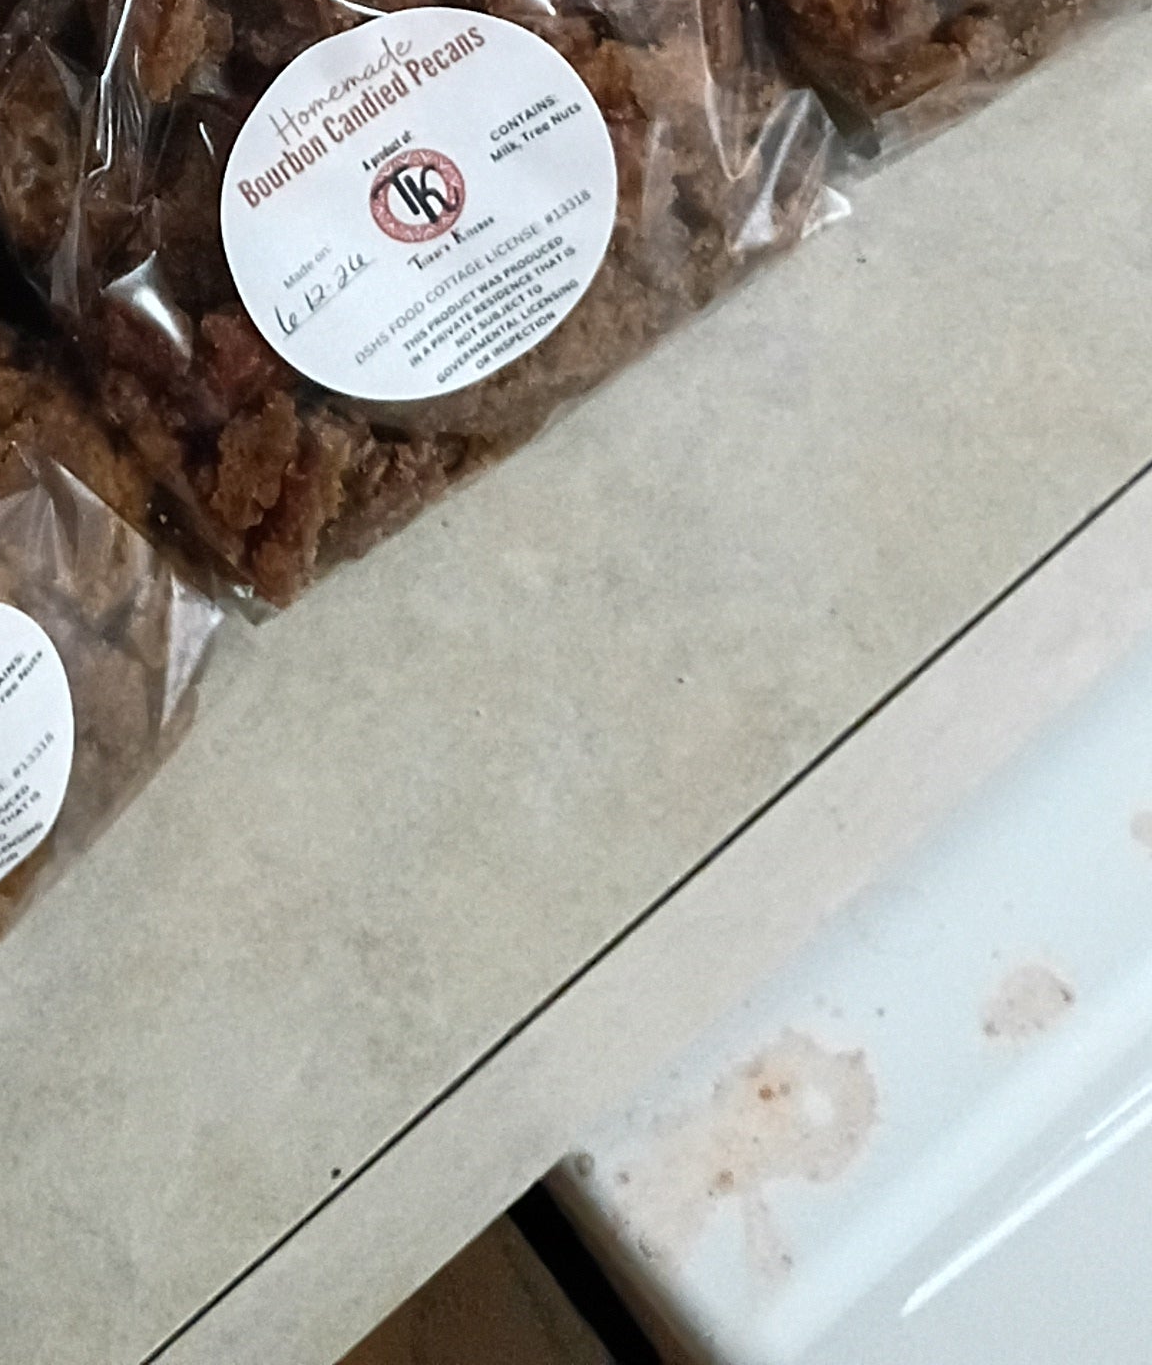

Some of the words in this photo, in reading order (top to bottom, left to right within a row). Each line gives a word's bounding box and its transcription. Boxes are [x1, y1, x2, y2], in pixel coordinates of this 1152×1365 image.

[237, 132, 329, 209] Bourbon
[322, 69, 410, 144] Candied
[404, 26, 486, 86] Pecans
[268, 36, 412, 146] Homemade
[490, 141, 523, 163] Milk,
[520, 121, 551, 142] Tree
[550, 102, 582, 126] Nuts
[370, 165, 460, 225] TK
[283, 261, 314, 289] Made
[355, 332, 390, 365] DSHS
[389, 300, 425, 336] FOOD
[425, 256, 486, 304] COTTAGE
[403, 329, 428, 353] THIS
[428, 290, 478, 332] PRODUCT
[476, 274, 504, 296] WAS
[504, 236, 564, 279] PRODUCED
[409, 352, 423, 367] IN
[423, 343, 432, 357] A
[430, 312, 475, 351] PRIVATE
[474, 272, 535, 316] RESIDENCE
[535, 255, 564, 278] THAT
[562, 246, 576, 261] IS
[454, 327, 478, 349] NOT
[479, 295, 525, 332] SUBJECT
[525, 284, 543, 301] TO
[436, 317, 519, 384] GOVERNMENTAL
[520, 278, 580, 321] LICENSING
[474, 353, 491, 370] OR
[490, 310, 557, 357] INSPECTION
